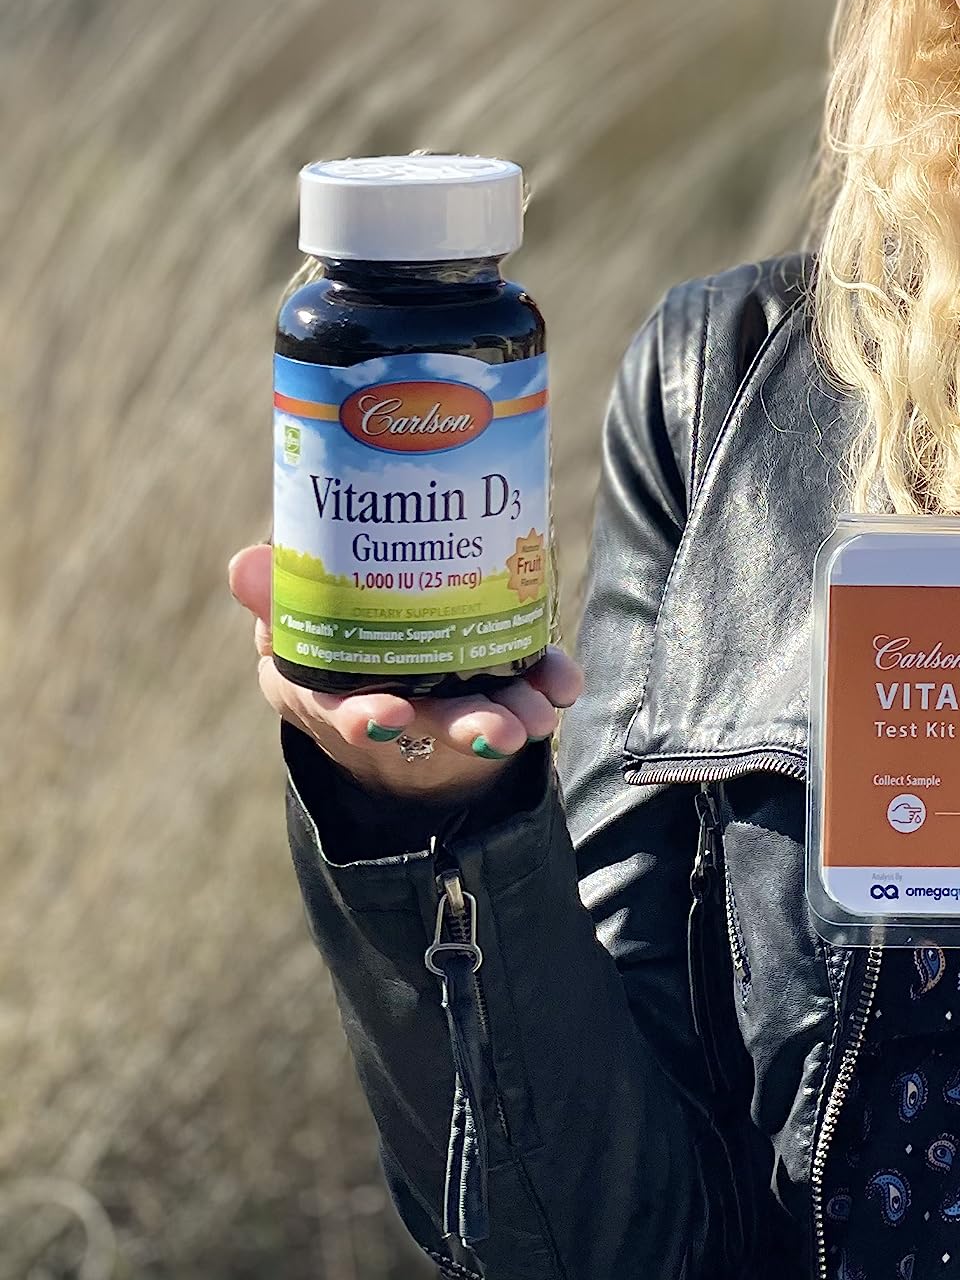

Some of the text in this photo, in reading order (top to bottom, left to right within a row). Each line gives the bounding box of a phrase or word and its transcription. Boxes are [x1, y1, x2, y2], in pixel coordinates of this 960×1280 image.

[357, 395, 474, 436] Carlson
[309, 474, 468, 524] Vitamin
[352, 532, 483, 562] Gummies
[352, 567, 482, 591] 1,000 IU (25 mcg)
[359, 627, 404, 641] Immune
[296, 635, 533, 664] 60 Vegetarian Gummies 60 Servings
[874, 721, 956, 738] Test Kit
[873, 774, 941, 789] Collect Sample
